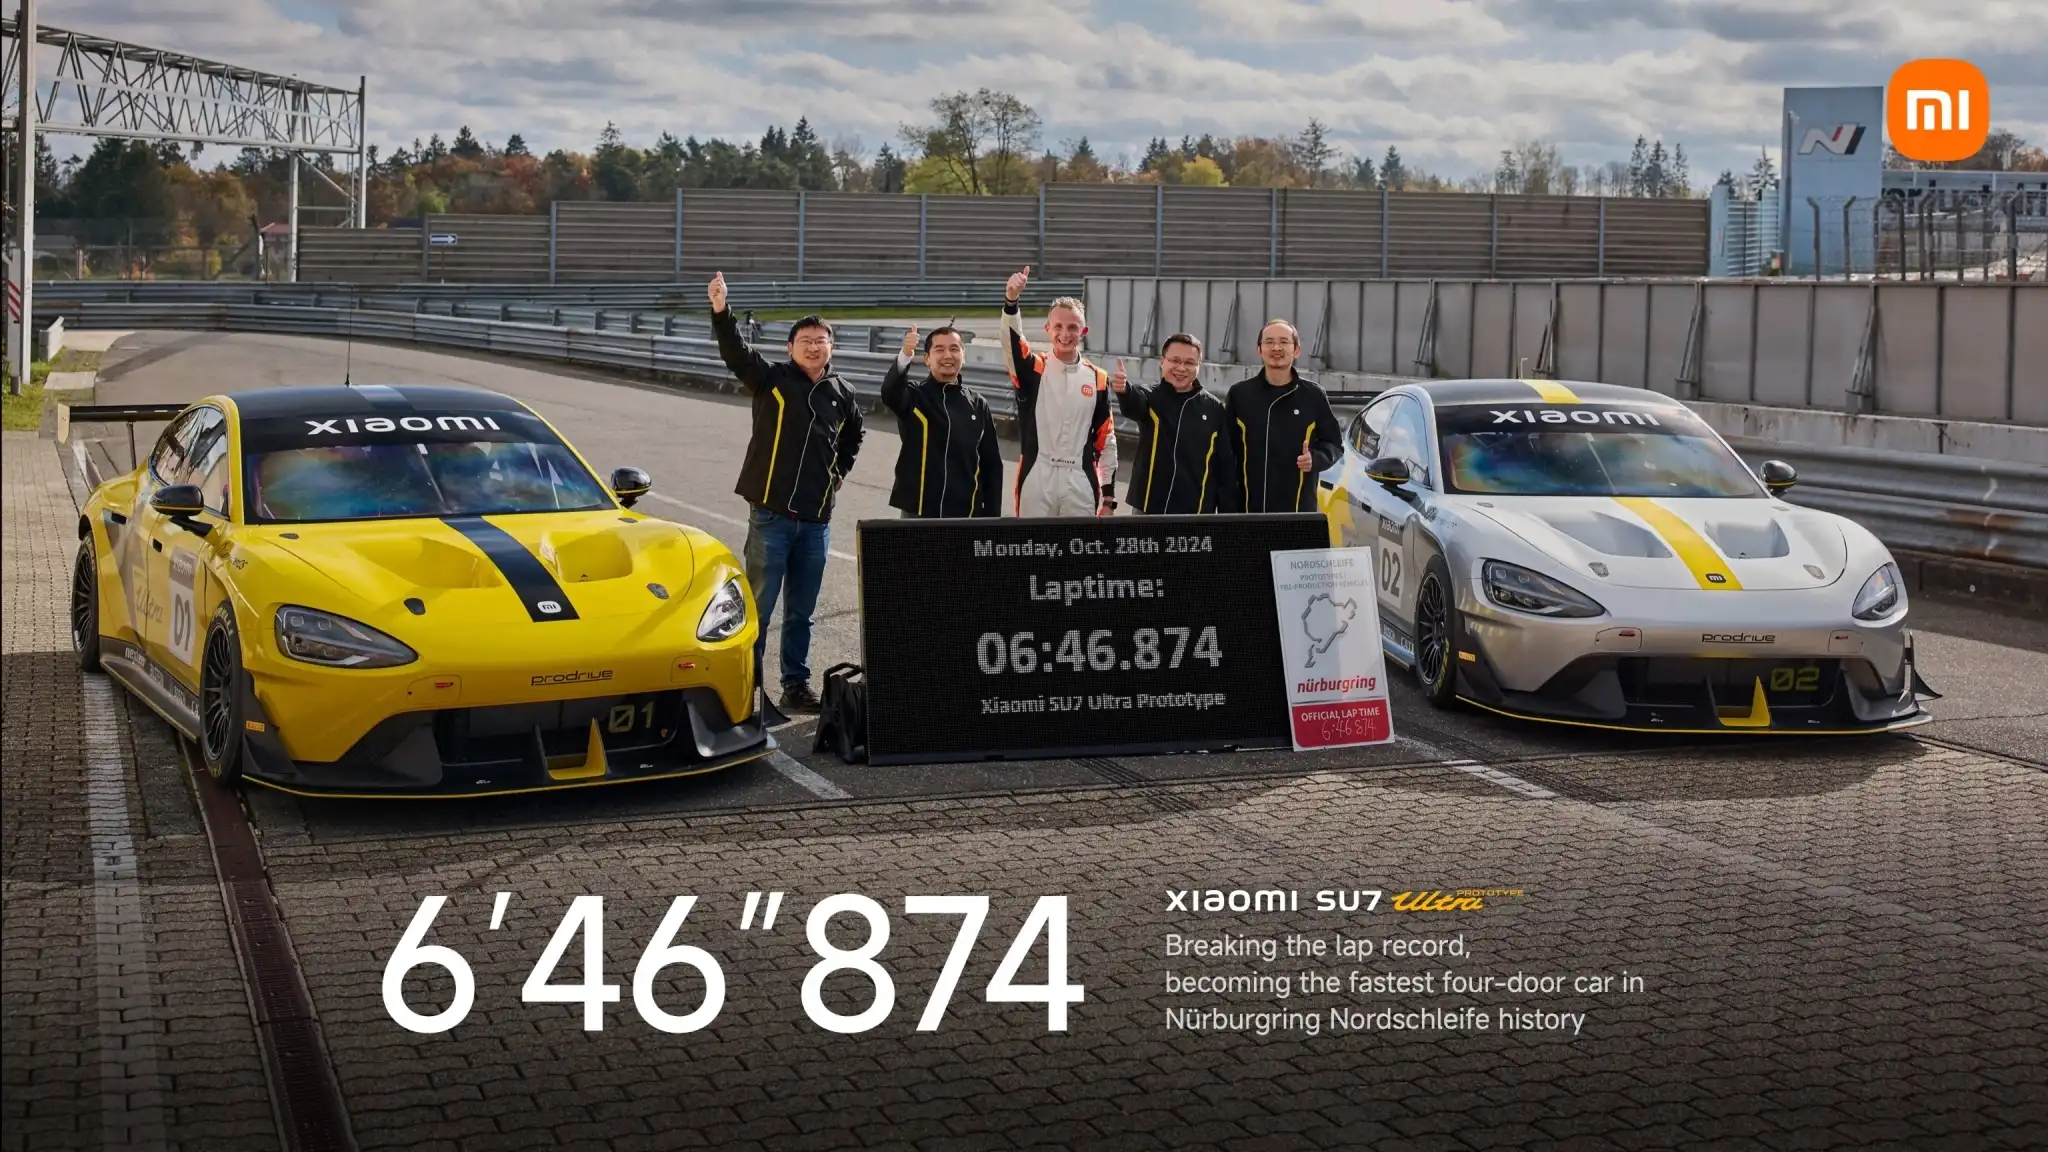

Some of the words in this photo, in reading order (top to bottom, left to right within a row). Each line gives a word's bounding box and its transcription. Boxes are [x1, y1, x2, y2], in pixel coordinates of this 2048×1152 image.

[973, 539, 1063, 558] Monday,
[1069, 538, 1110, 555] Oct.
[1115, 537, 1159, 554] 28th
[1165, 535, 1213, 553] 2024
[1381, 547, 1401, 598] 02
[1029, 573, 1164, 607] Laptime:
[173, 593, 192, 652] 01
[976, 625, 1223, 675] 06:46.874
[1297, 676, 1377, 694] nürburgring
[1769, 667, 1820, 692] 02
[607, 701, 656, 733] 01
[980, 695, 1045, 715] Xiaomi
[1088, 693, 1132, 710] Ultra
[1136, 692, 1226, 711] Prototype
[1301, 711, 1341, 722] OFFICIAL
[1342, 709, 1358, 718] LAP
[1359, 707, 1380, 716] TIME
